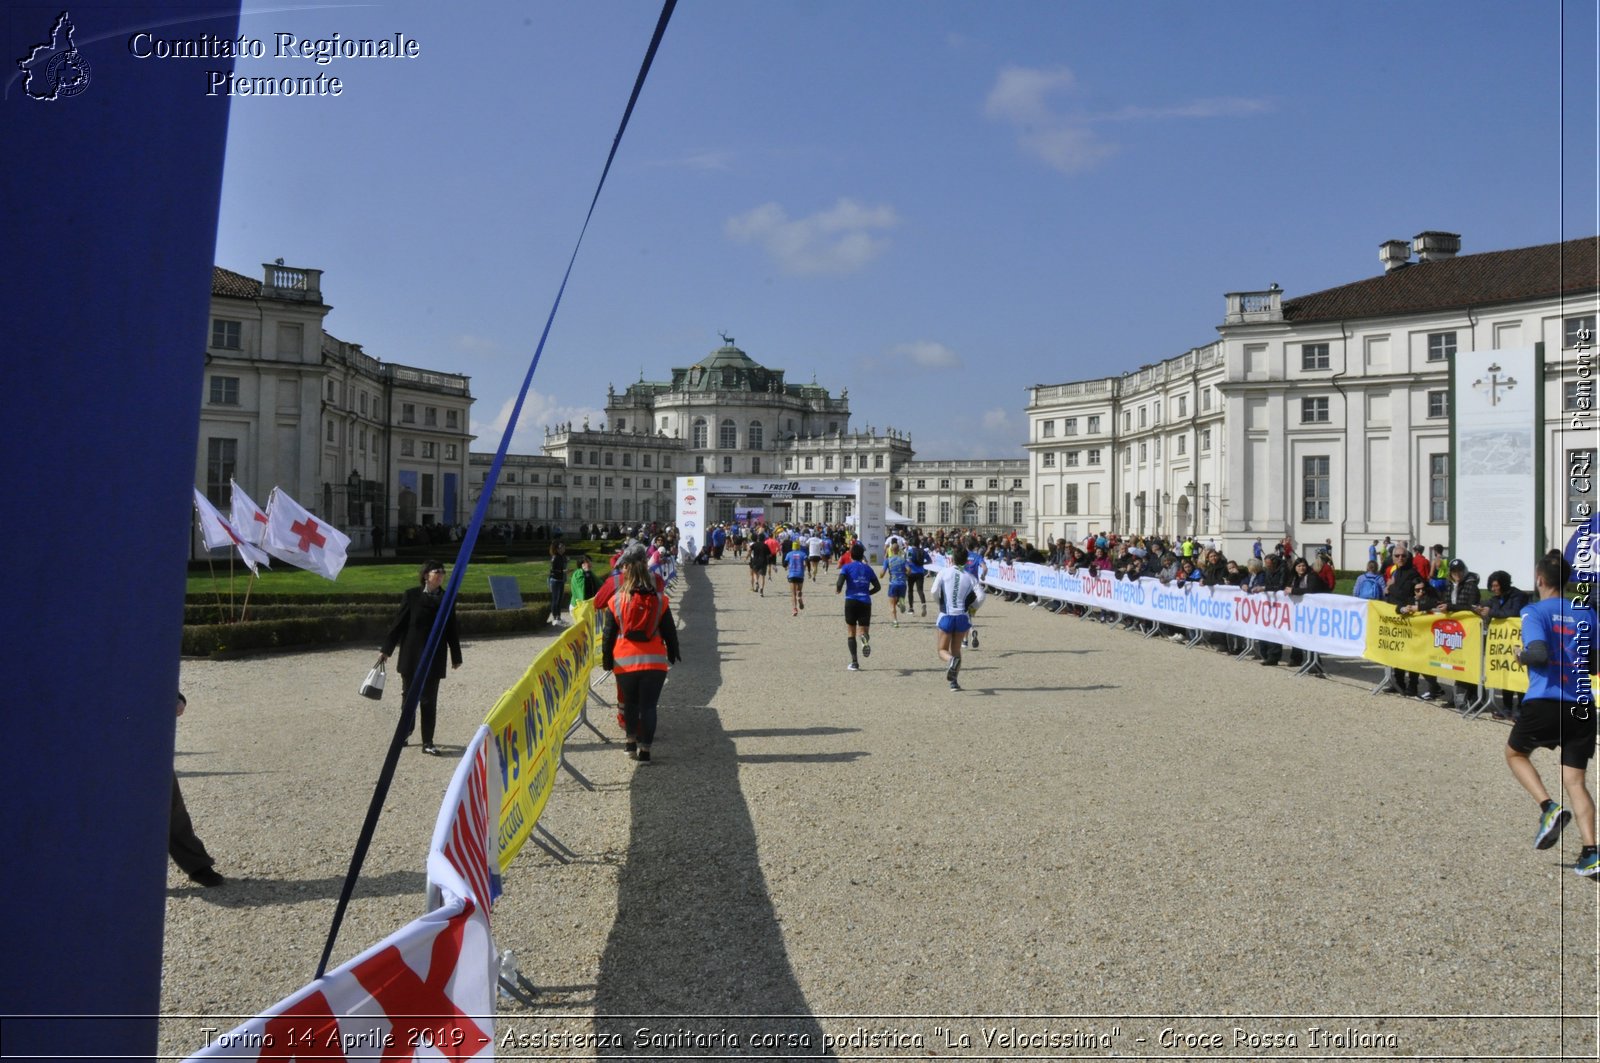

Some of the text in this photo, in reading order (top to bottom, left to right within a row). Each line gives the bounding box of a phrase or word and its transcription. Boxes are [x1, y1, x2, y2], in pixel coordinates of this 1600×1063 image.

[1082, 576, 1112, 600] TOYOTA
[1114, 581, 1146, 606] HYBRID
[1152, 588, 1364, 641] Central Motors TOYOTA HYBRID
[1379, 626, 1413, 640] BIRAGHINI
[1433, 627, 1463, 651] Biraghi
[1489, 628, 1508, 640] HAI
